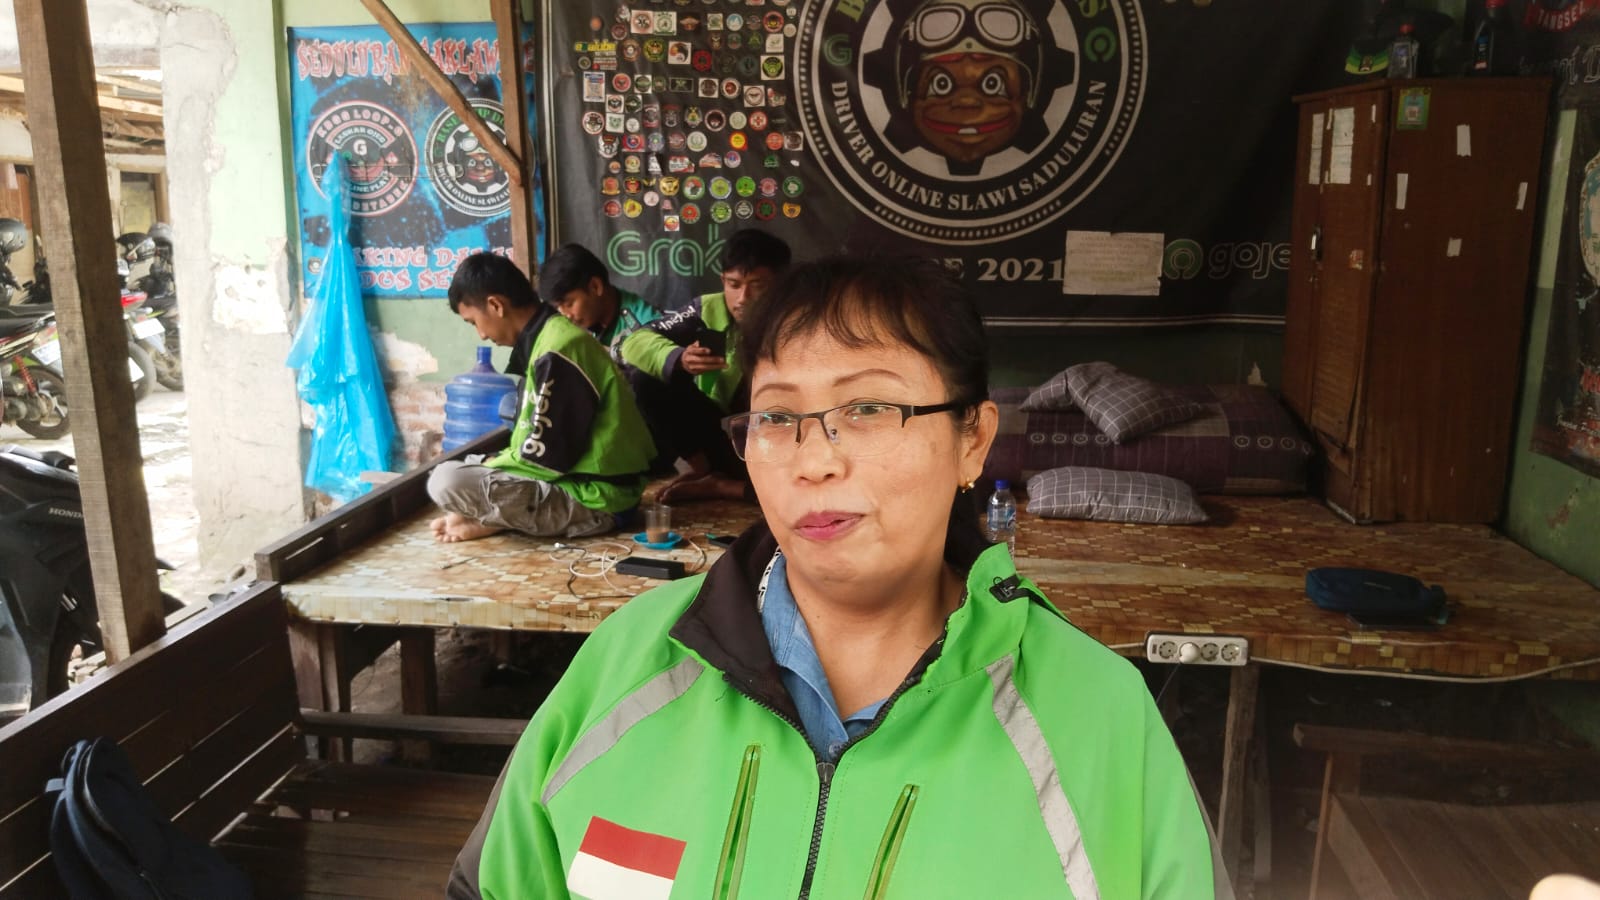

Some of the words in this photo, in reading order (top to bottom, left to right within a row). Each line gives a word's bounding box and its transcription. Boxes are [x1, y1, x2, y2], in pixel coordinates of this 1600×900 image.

[1537, 1, 1587, 30] TANGSEL
[831, 80, 874, 166] DRIVER
[871, 158, 944, 210] ONLINE
[947, 185, 1018, 212] SLAWI
[1017, 79, 1107, 196] SADULURAN
[977, 257, 1064, 282] 2021
[1207, 241, 1293, 280] goje
[48, 507, 84, 519] HOND
